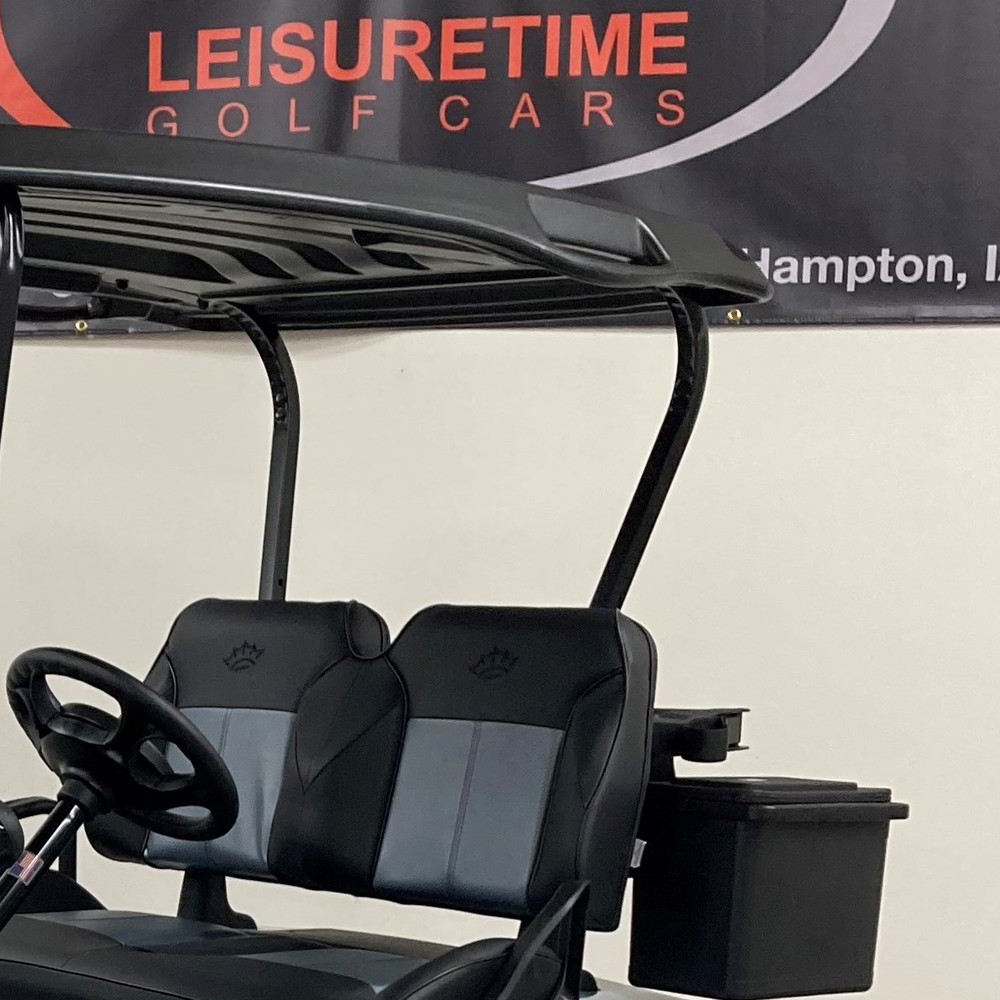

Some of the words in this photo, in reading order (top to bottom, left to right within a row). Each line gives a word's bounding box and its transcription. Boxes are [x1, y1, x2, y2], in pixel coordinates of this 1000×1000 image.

[147, 11, 688, 93] LEISURETIME
[146, 94, 378, 138] GOLF
[438, 89, 687, 132] CARS
[985, 244, 1000, 282] I
